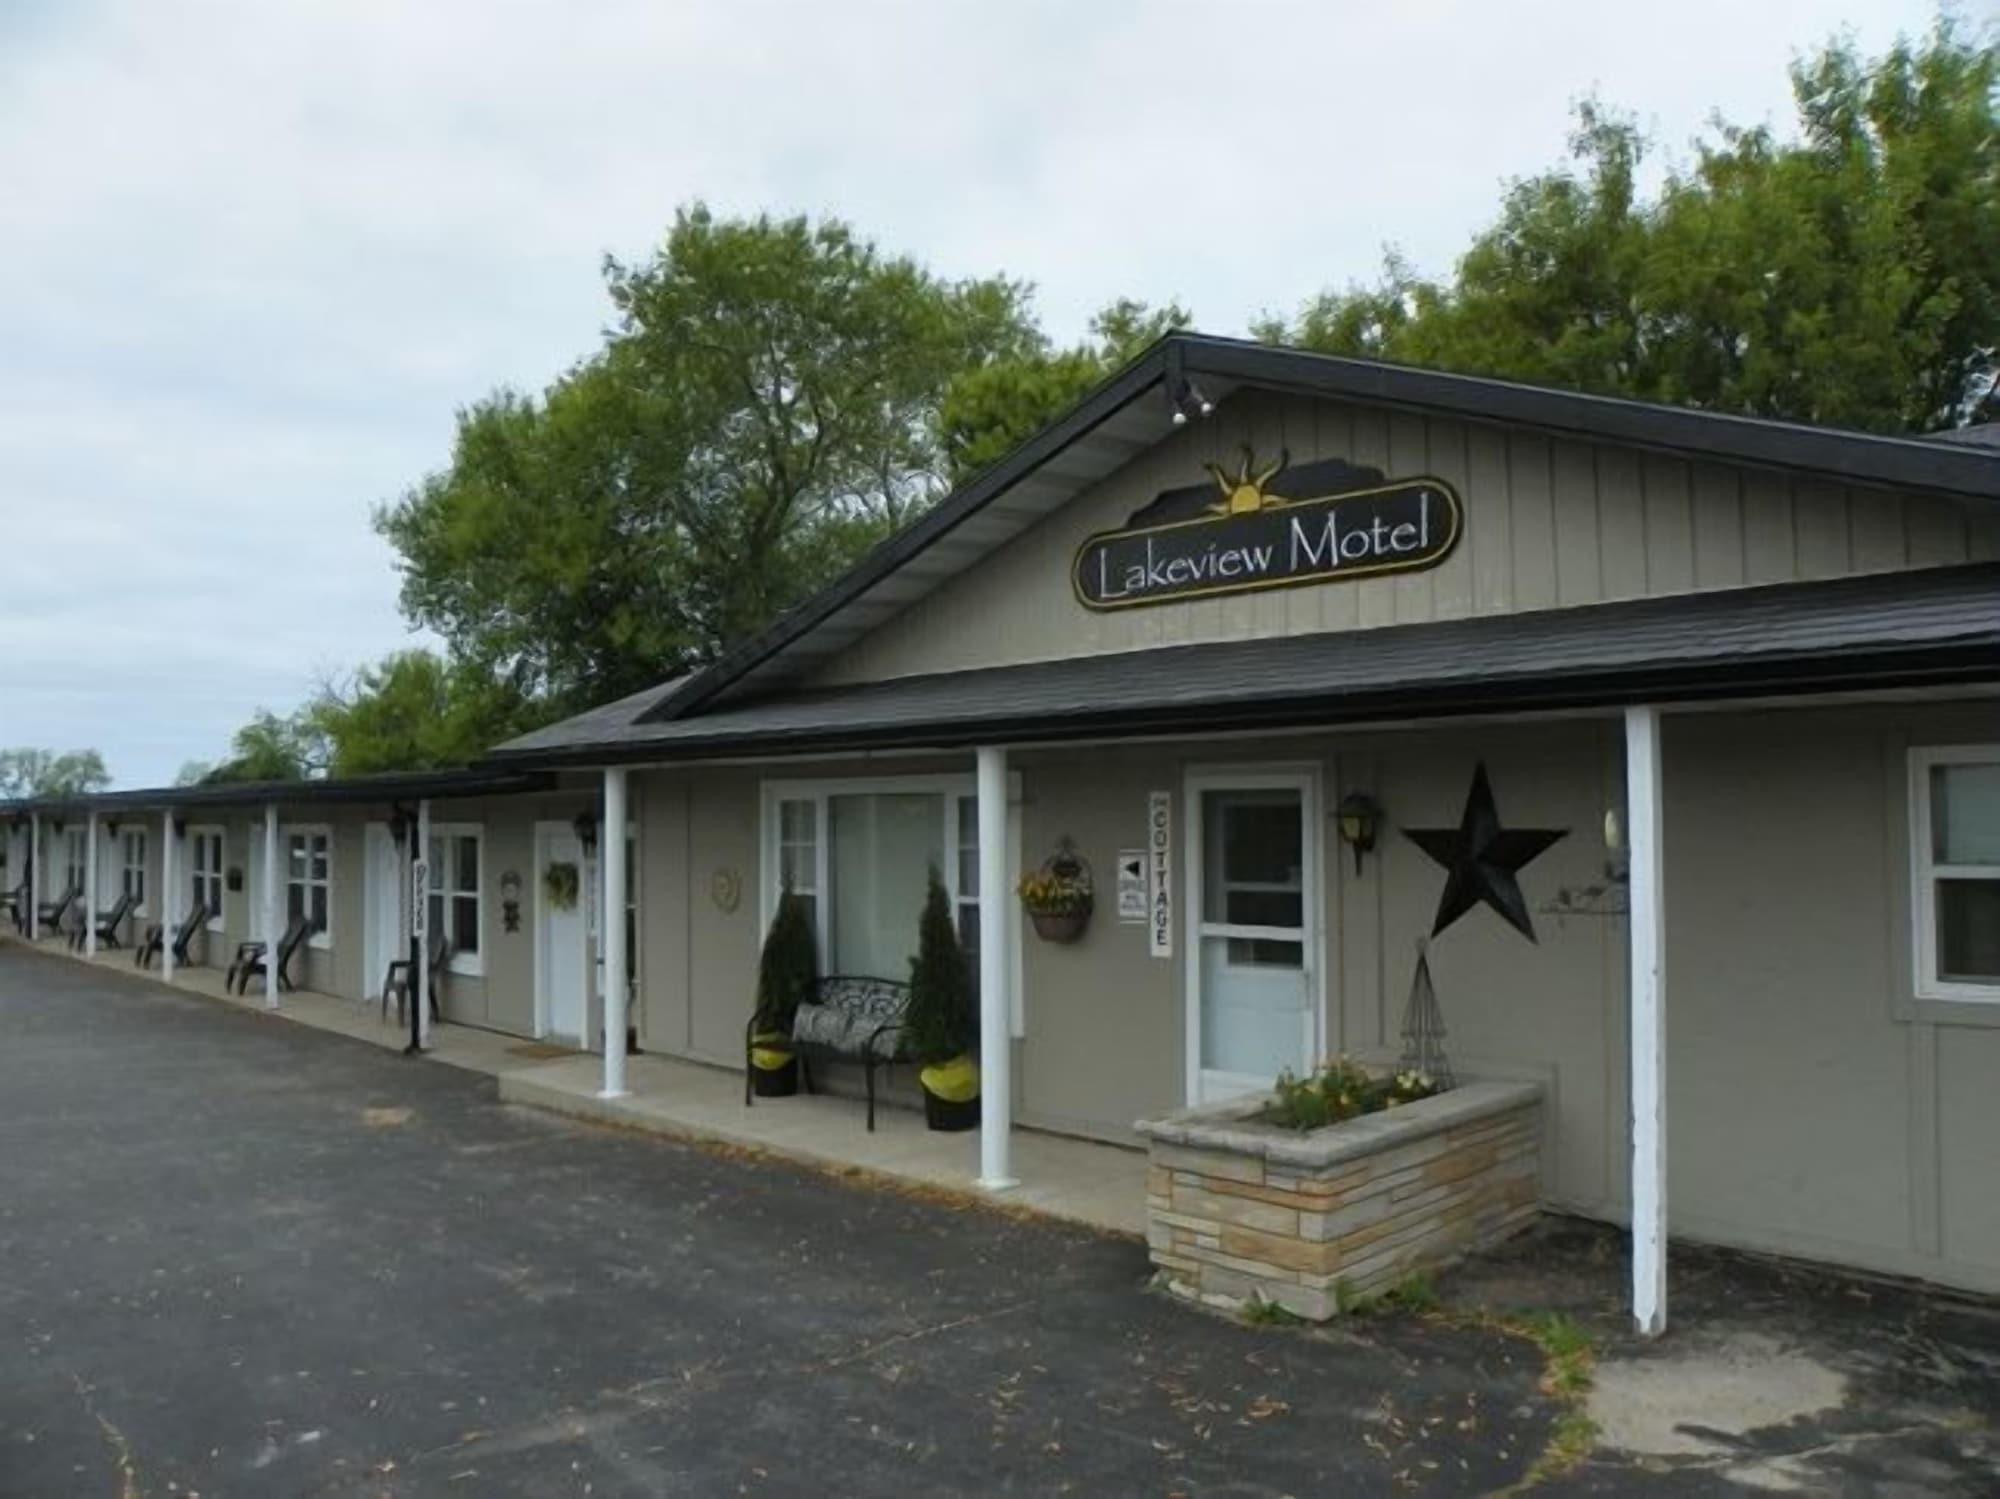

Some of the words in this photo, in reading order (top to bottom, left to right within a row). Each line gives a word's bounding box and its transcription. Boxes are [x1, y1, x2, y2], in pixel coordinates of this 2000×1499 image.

[1099, 536, 1273, 599] Lakeview
[1289, 492, 1429, 572] Motel
[1154, 811, 1168, 946] COTTAGE
